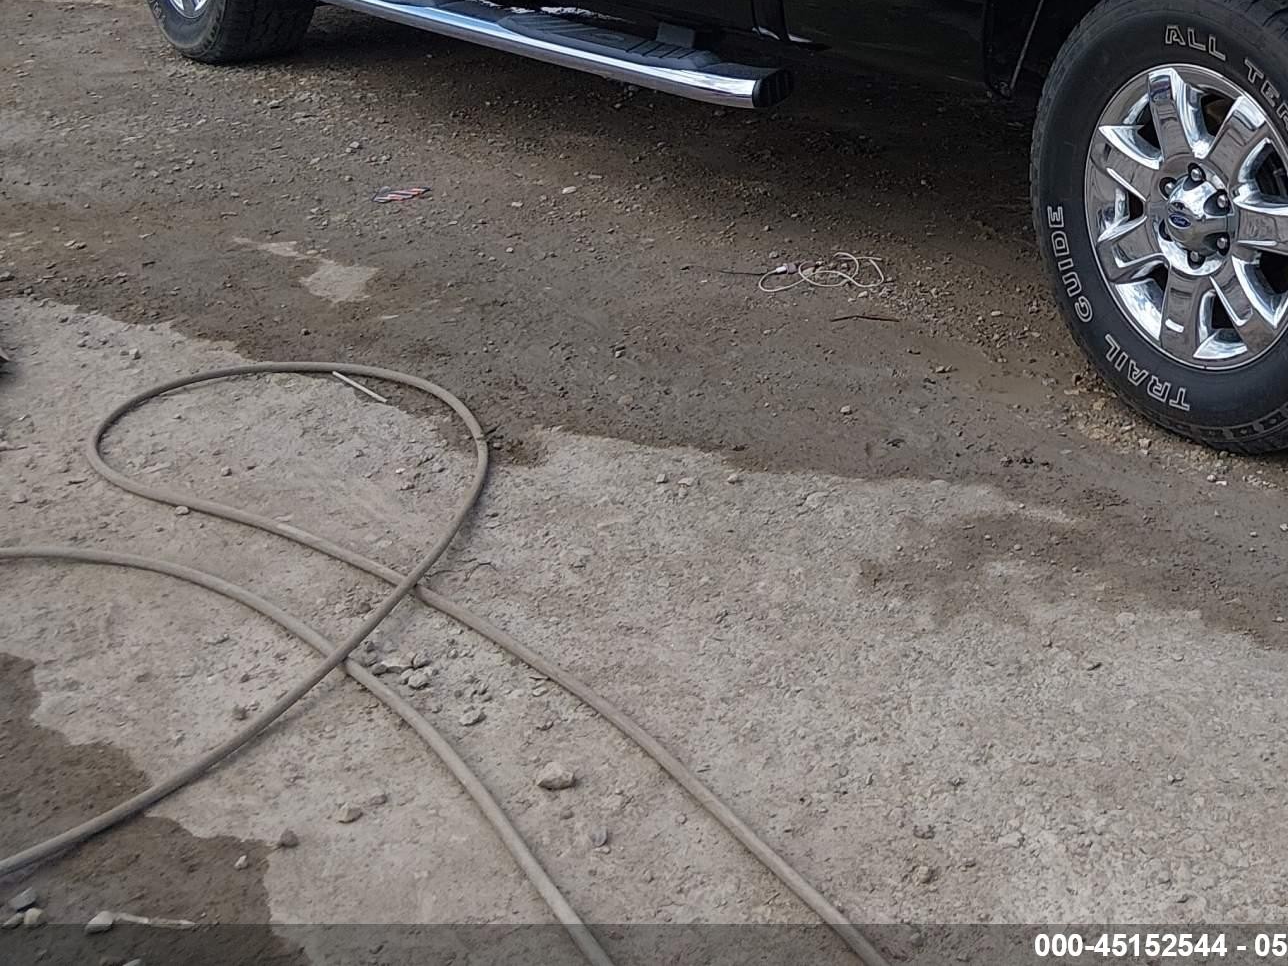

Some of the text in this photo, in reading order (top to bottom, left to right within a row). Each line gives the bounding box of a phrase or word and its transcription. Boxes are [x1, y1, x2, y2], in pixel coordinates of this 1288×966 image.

[1165, 25, 1226, 62] ALL
[1047, 206, 1191, 411] TRAIL GUIDE
